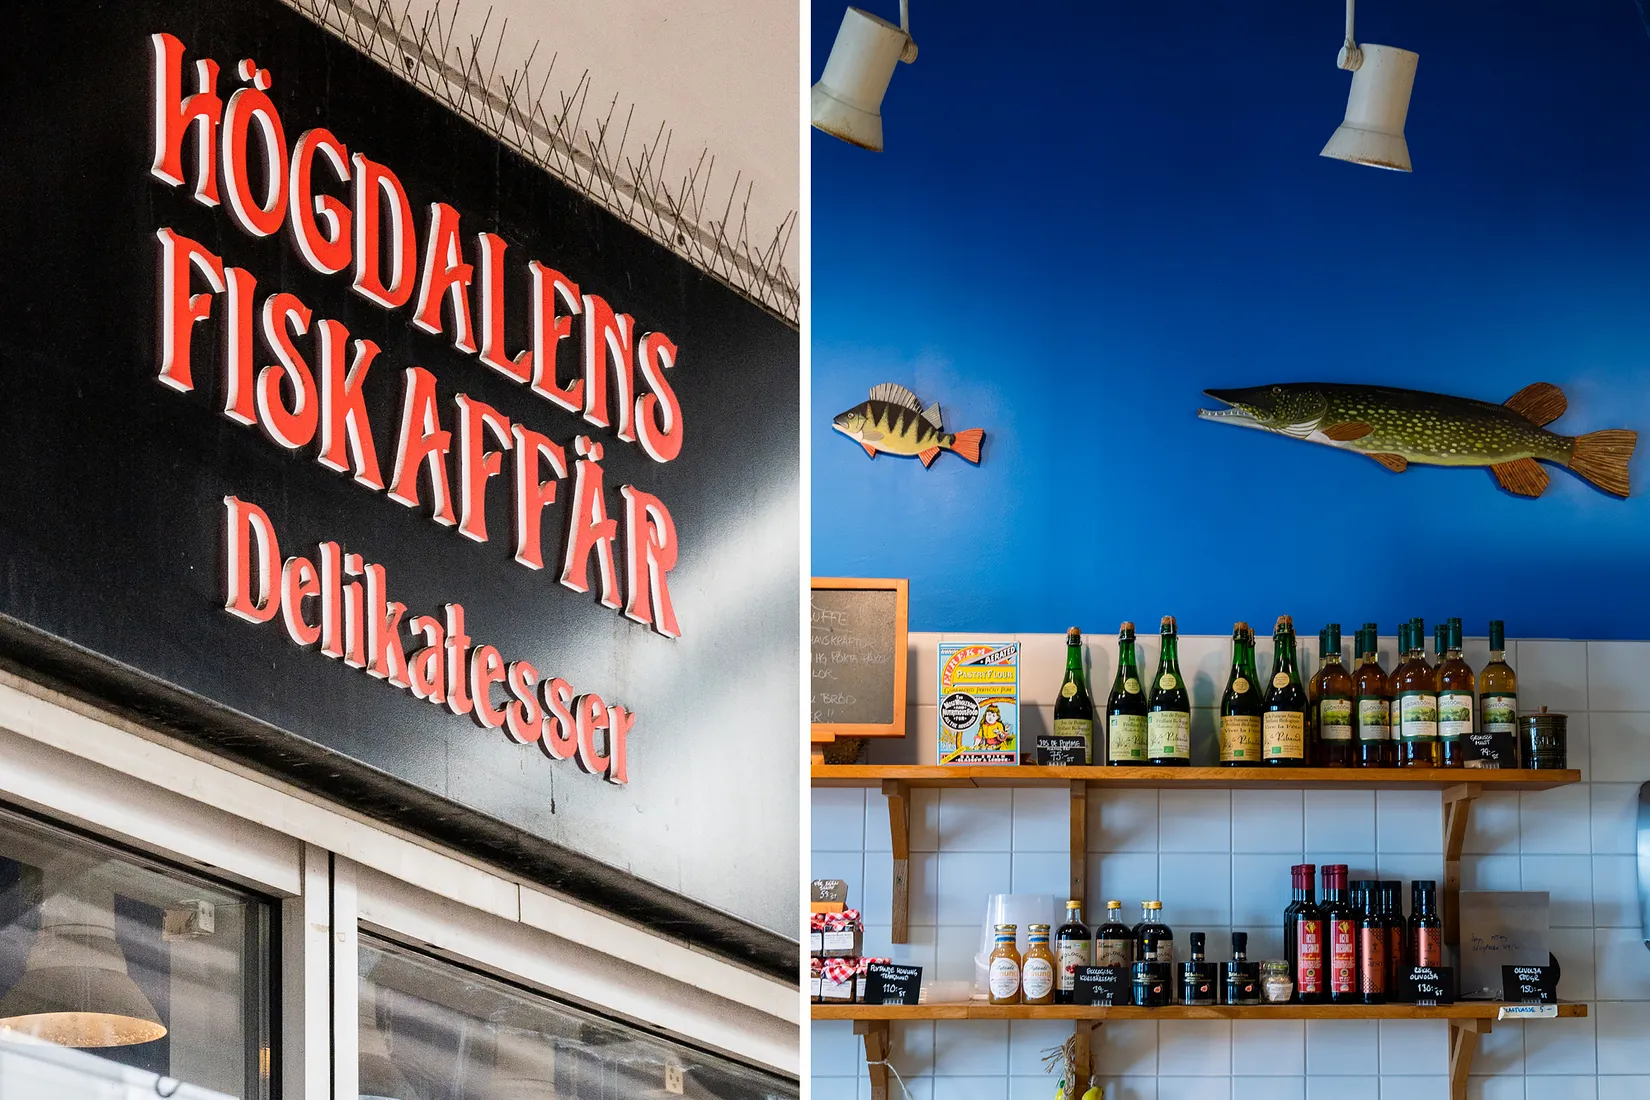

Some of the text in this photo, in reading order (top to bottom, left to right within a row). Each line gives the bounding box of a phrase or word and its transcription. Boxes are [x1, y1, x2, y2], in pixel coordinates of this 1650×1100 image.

[150, 32, 684, 464] HÖGDALENS
[156, 227, 682, 640] FISKAFFÄR
[223, 494, 636, 786] Delikatesser
[820, 691, 857, 704] BRÖD
[984, 646, 1016, 665] AERATED
